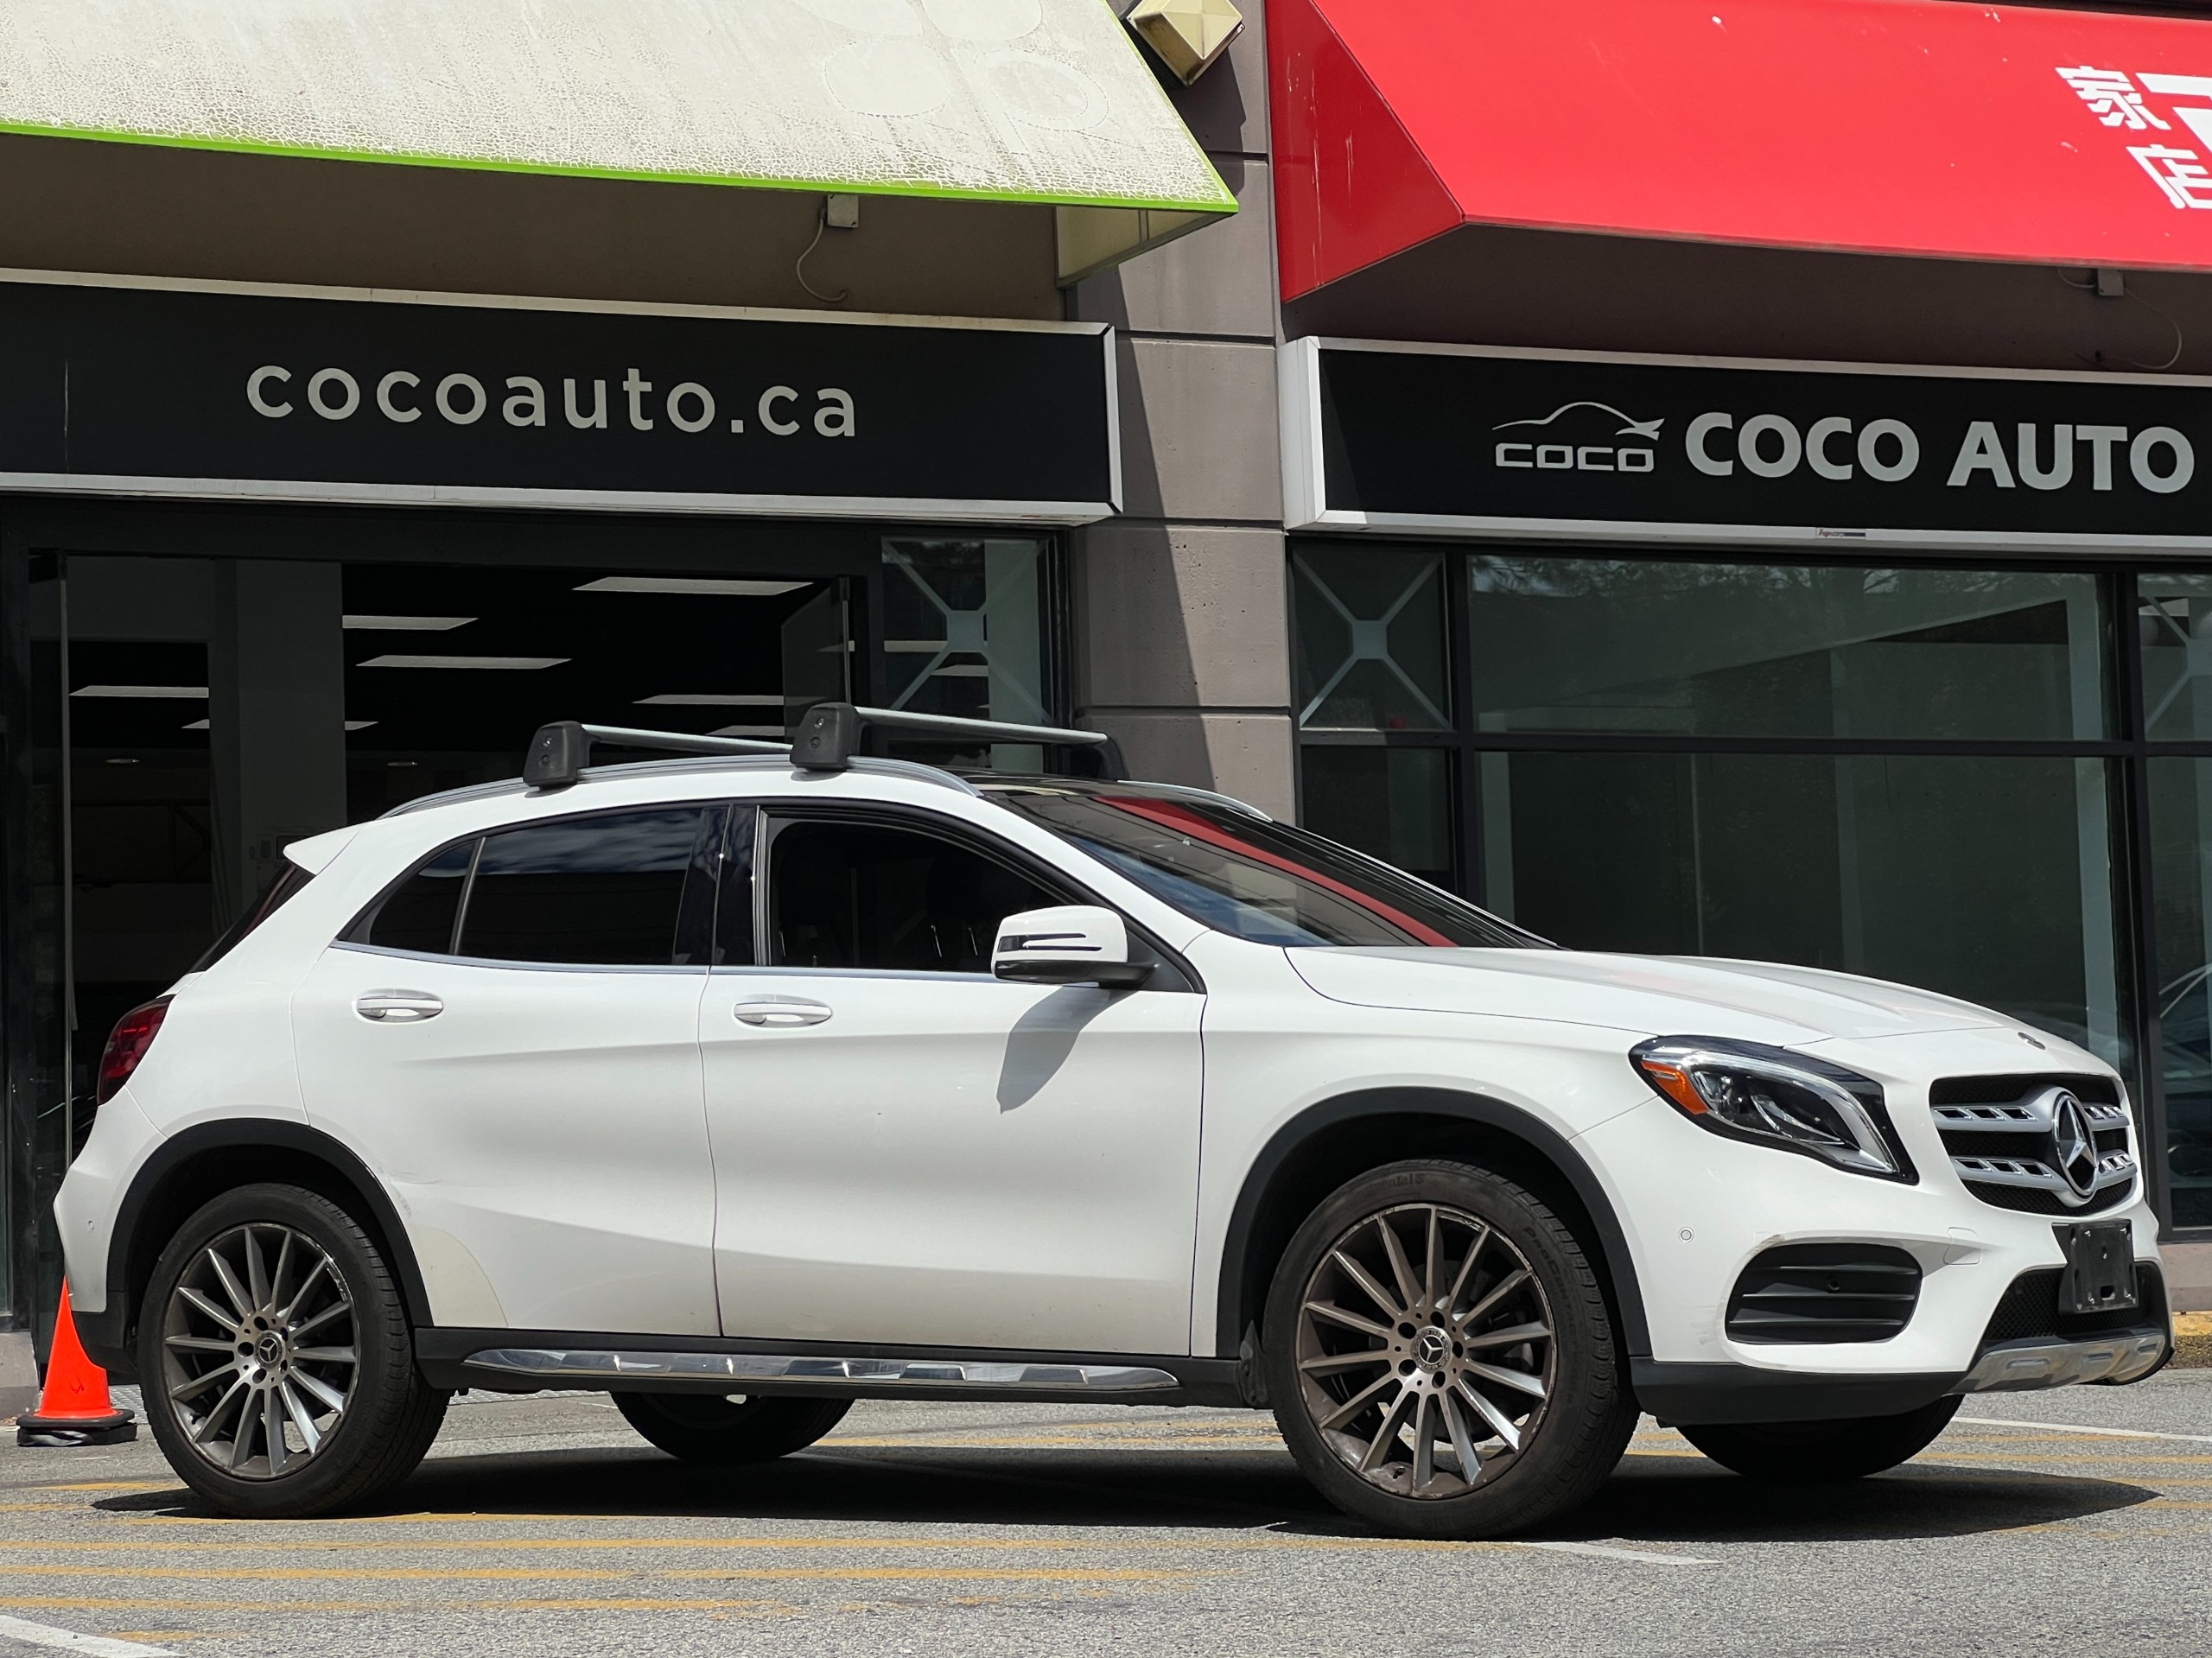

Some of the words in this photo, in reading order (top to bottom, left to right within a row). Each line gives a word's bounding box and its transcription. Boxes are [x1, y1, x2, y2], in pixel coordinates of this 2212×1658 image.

[246, 365, 855, 437] cocoauto.ca
[1496, 442, 1655, 473] COCO
[1685, 411, 1920, 482] COCO
[1947, 421, 2196, 493] AUTO
